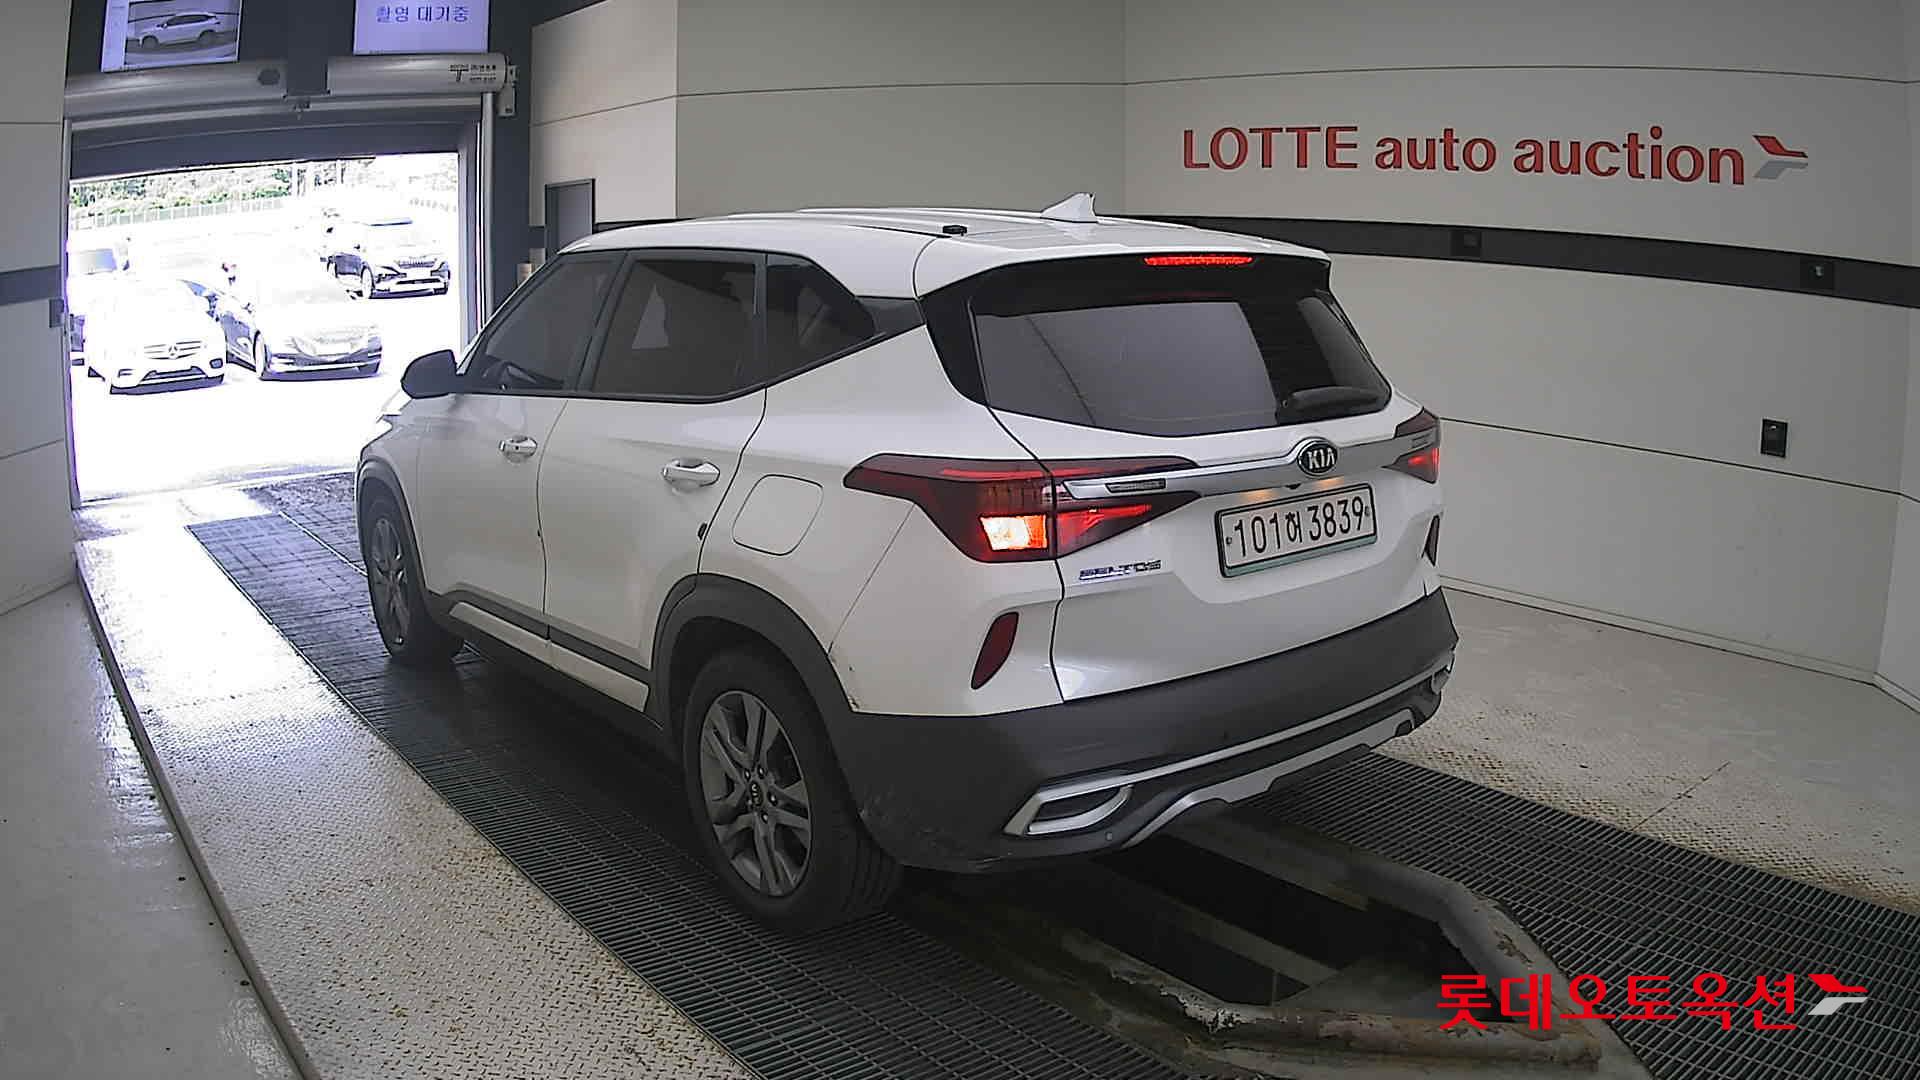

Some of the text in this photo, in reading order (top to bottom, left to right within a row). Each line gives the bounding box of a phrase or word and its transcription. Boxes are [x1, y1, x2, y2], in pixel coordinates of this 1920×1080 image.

[417, 6, 468, 23] 대기중
[1183, 125, 1745, 185] LOTTE auto auction
[1307, 447, 1336, 469] KIA
